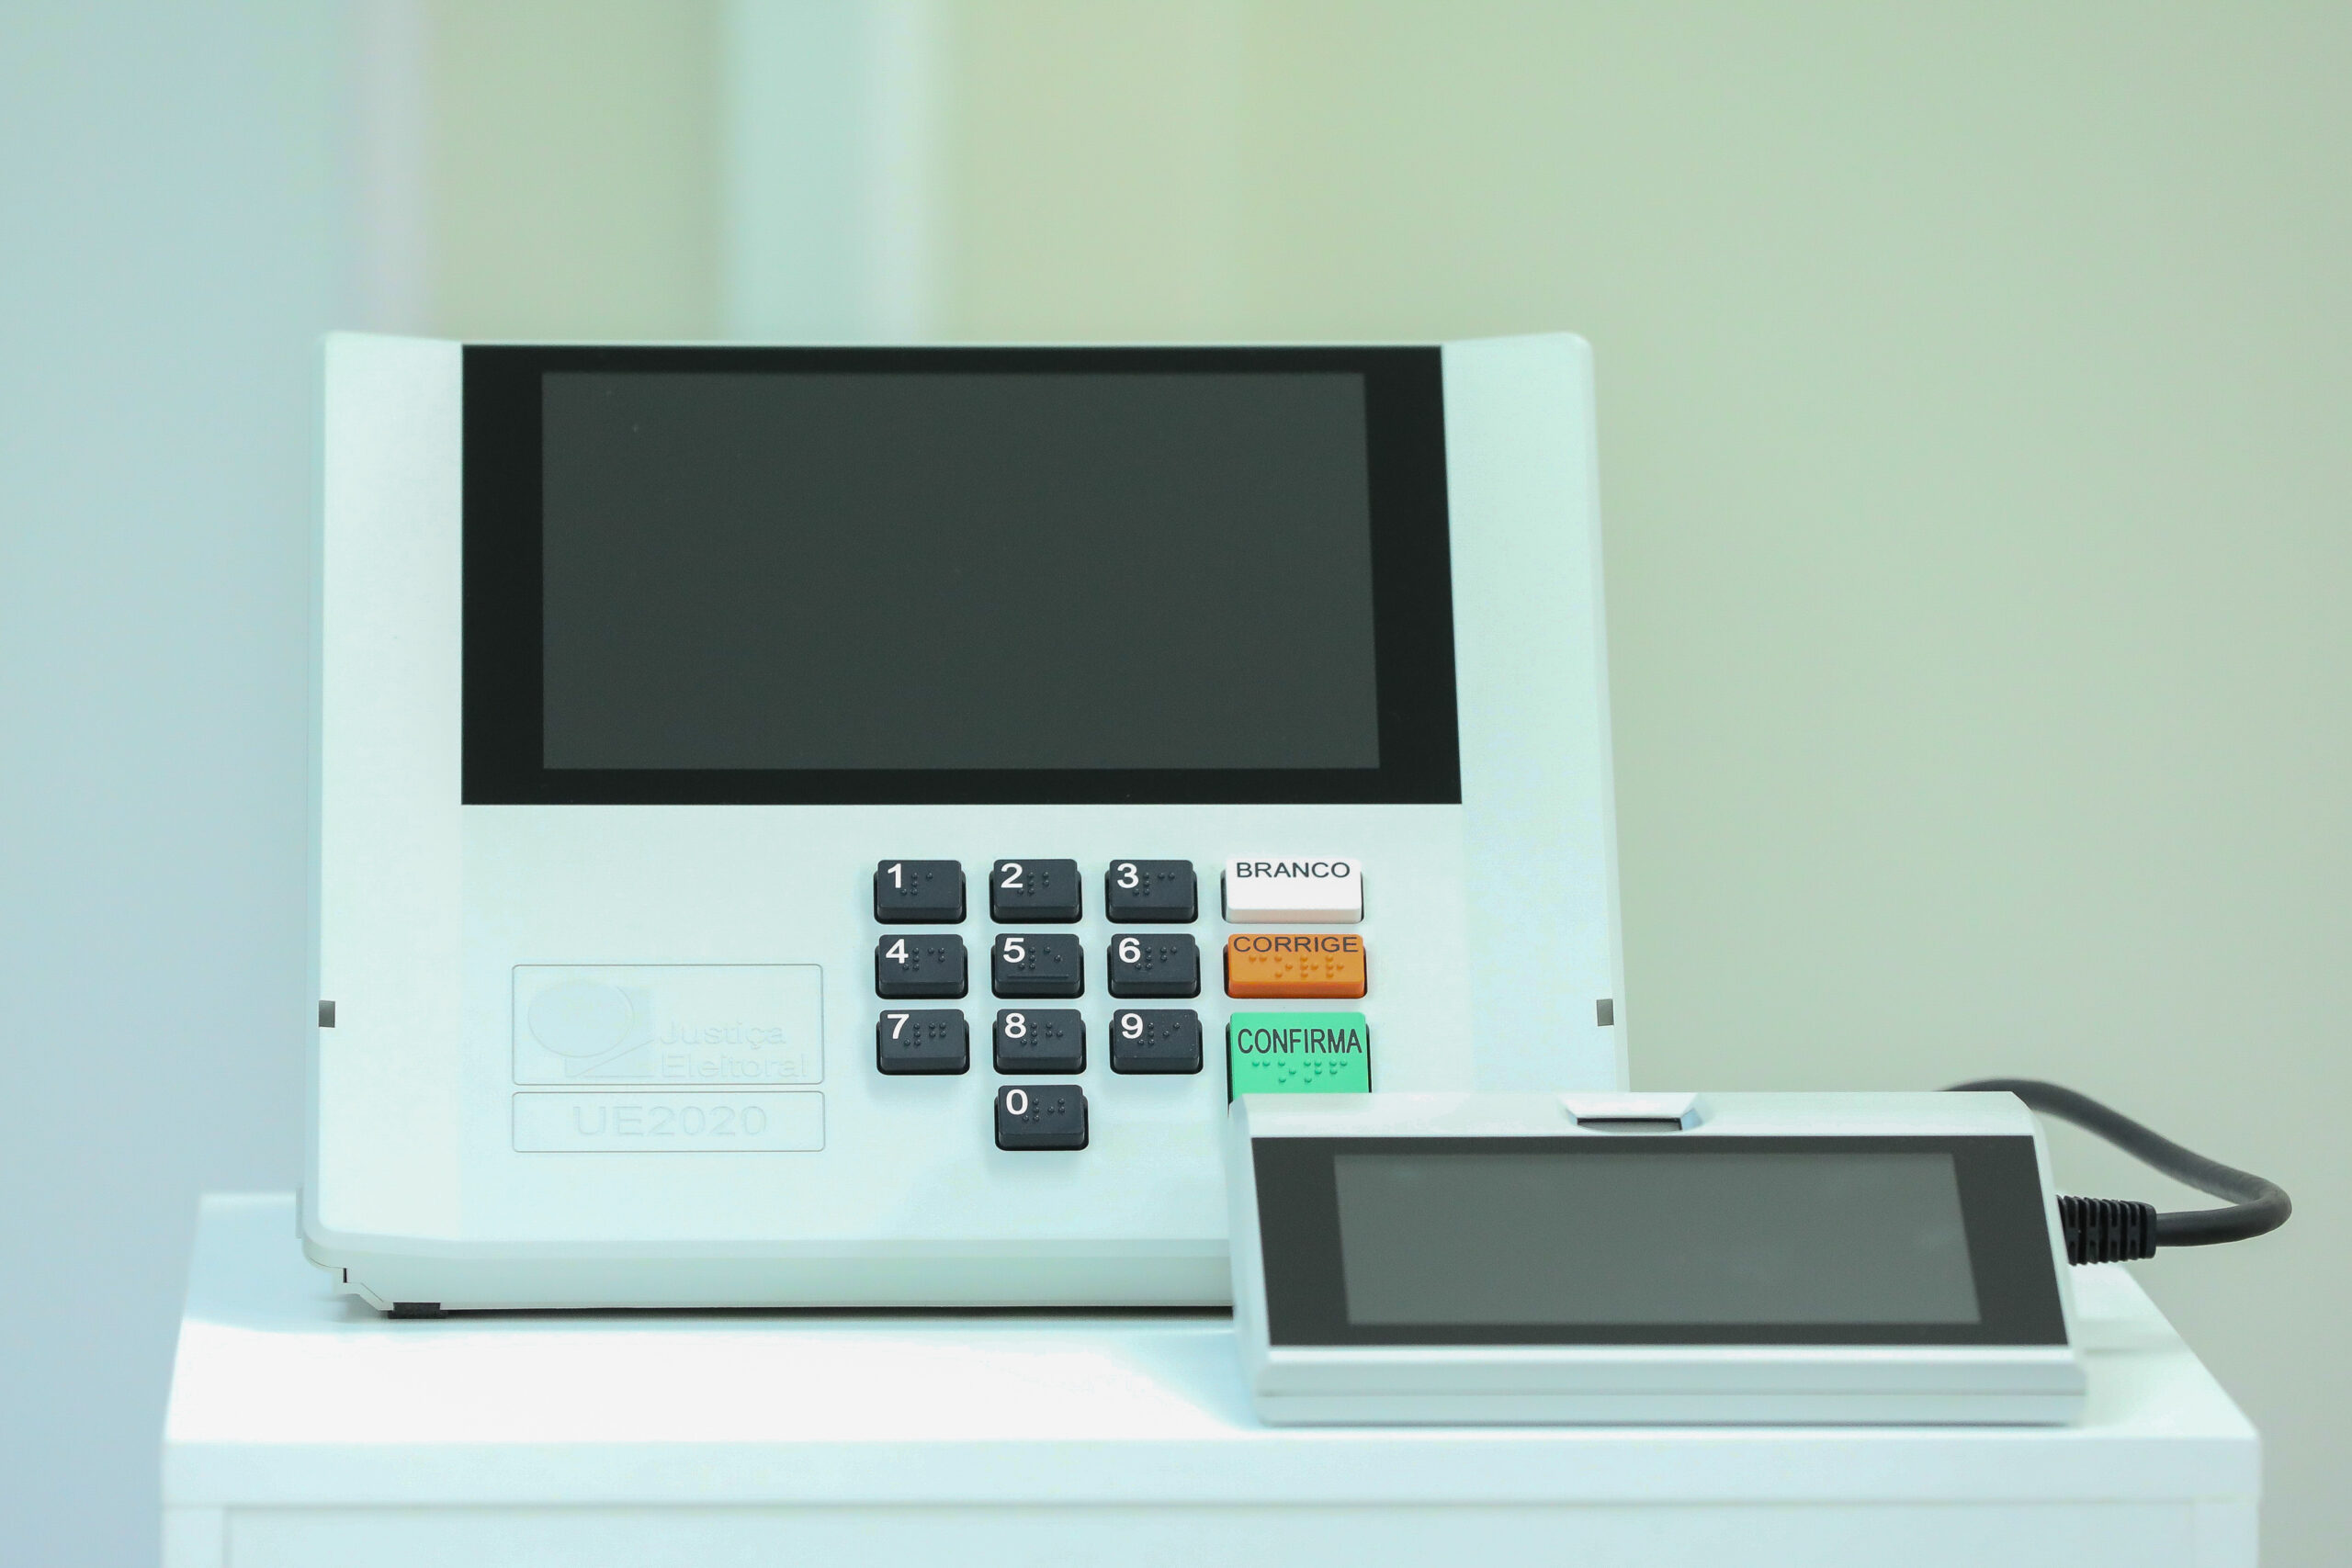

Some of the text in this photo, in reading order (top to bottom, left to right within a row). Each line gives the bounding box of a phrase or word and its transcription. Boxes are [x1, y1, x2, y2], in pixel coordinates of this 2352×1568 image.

[888, 863, 901, 888] 1
[1001, 863, 1023, 888] 2
[1117, 863, 1138, 888] 3
[1237, 863, 1350, 877] BRANCO
[886, 939, 909, 964] 4
[1003, 938, 1025, 963] 5
[1119, 938, 1140, 963] 6
[1234, 937, 1357, 952] CORRIGE
[659, 1021, 786, 1049] Justiça
[888, 1014, 909, 1039] 7
[1005, 1013, 1026, 1038] 8
[1121, 1013, 1143, 1039] 9
[1238, 1029, 1362, 1054] CONFIRMA
[662, 1053, 808, 1078] Eleitoral
[1006, 1089, 1028, 1115] 0
[573, 1106, 767, 1136] UE2020
